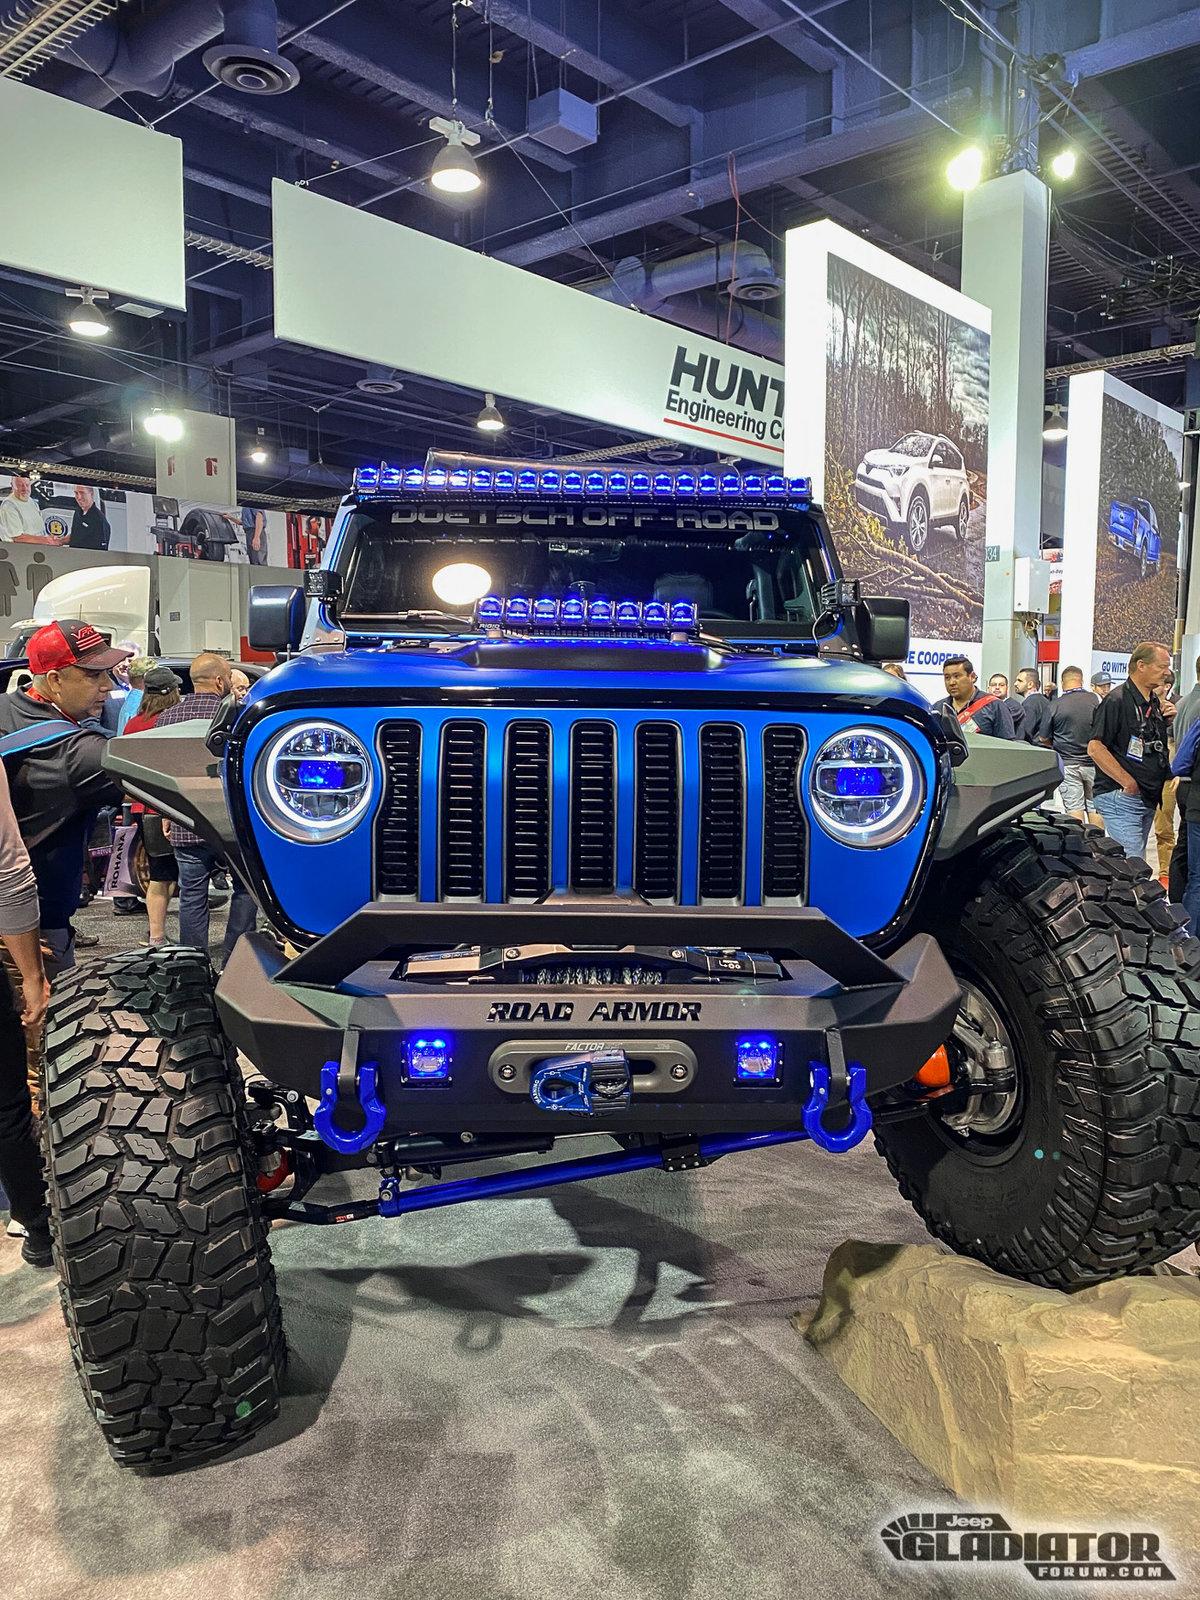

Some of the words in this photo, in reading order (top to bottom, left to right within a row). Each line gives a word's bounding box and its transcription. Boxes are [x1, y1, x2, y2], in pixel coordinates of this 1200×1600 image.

[665, 389, 767, 440] Engineering
[391, 505, 574, 525] DOETSCH
[1101, 661, 1111, 672] GO
[1111, 661, 1128, 673] WITH
[111, 833, 126, 888] ROHANA
[486, 1002, 575, 1022] ROAD
[587, 1001, 703, 1022] ARMOR
[564, 1042, 605, 1051] FACTOR
